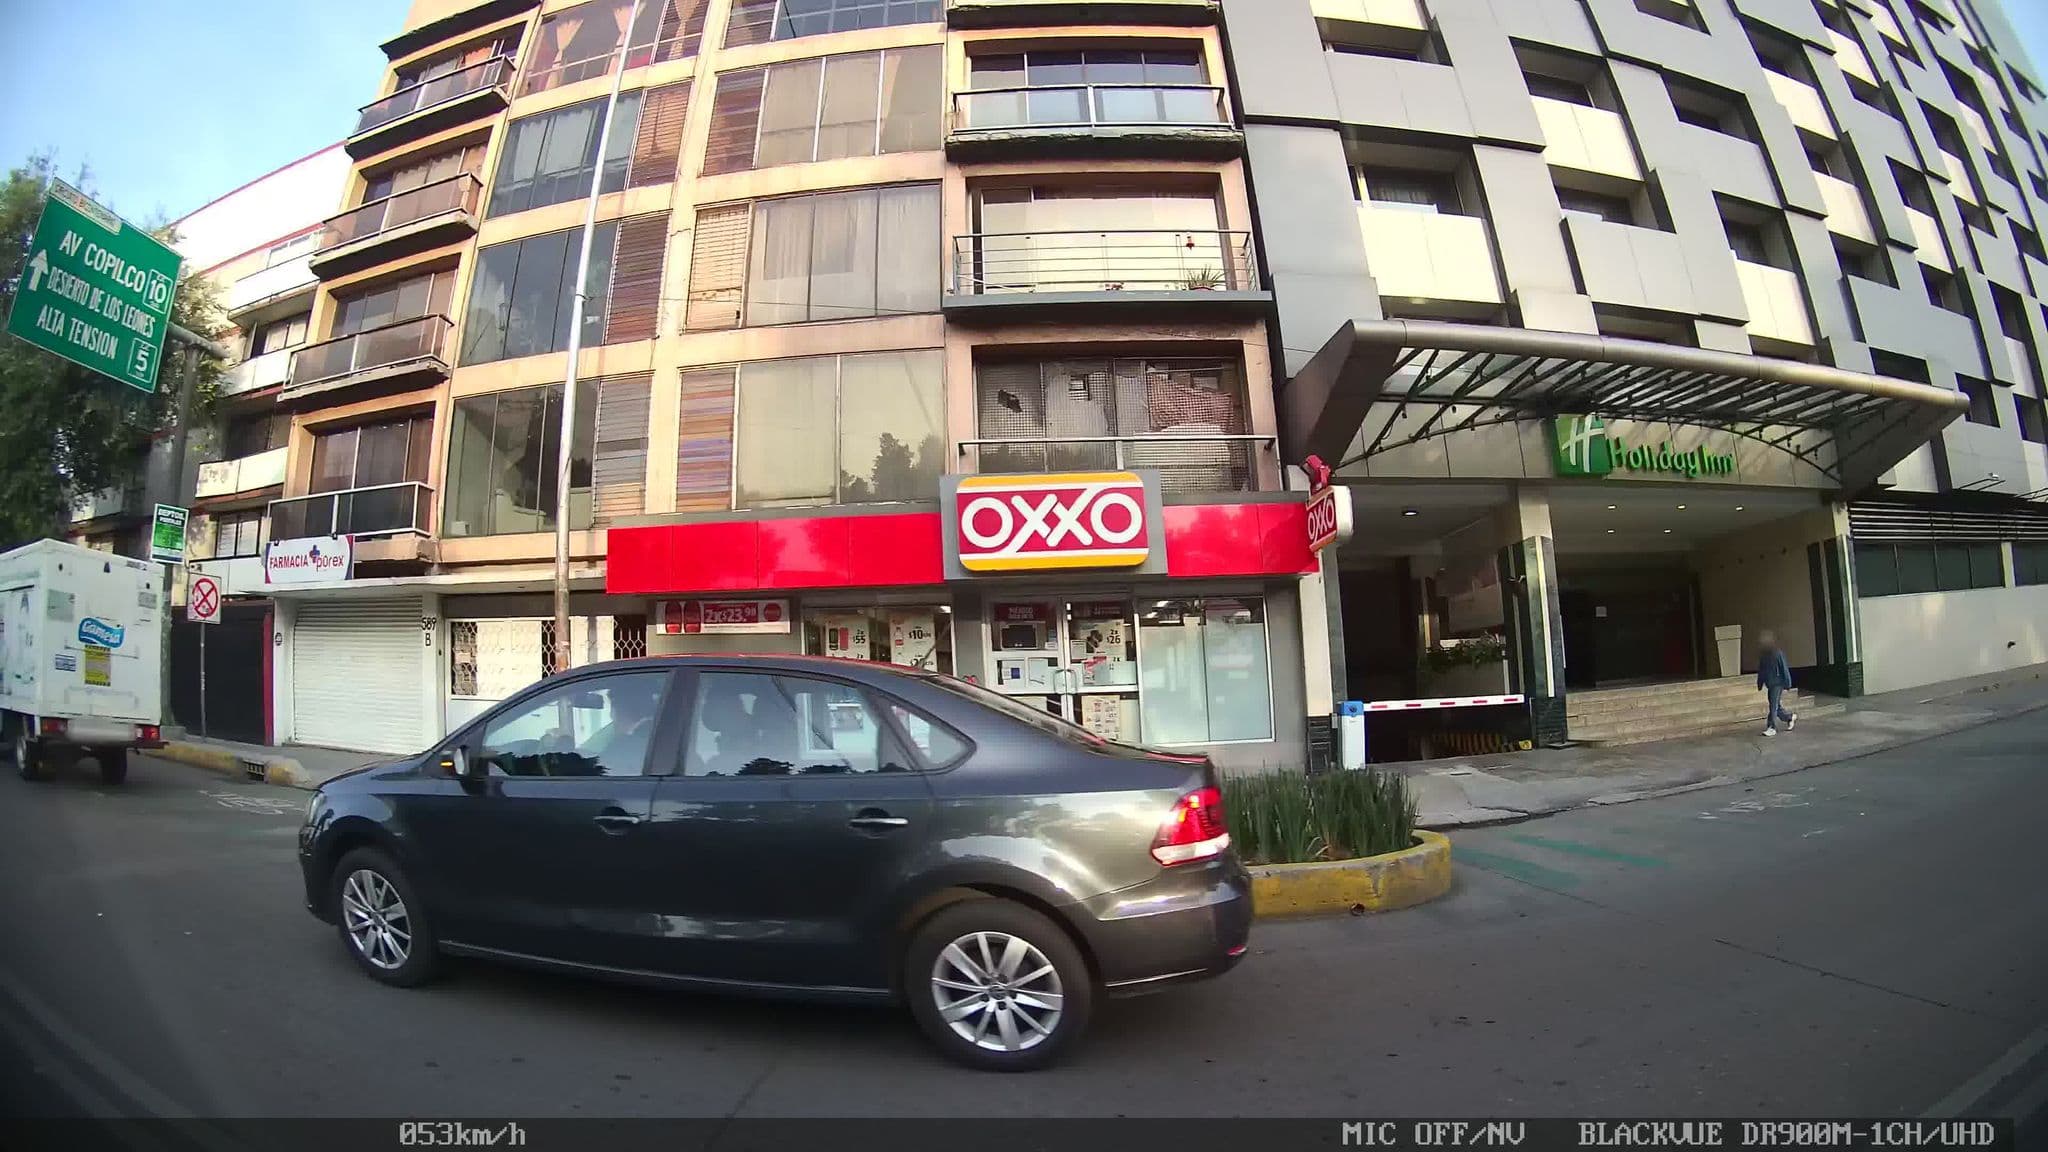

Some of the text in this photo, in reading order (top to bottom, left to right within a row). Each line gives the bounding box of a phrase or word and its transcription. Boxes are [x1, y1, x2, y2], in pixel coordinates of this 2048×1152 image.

[59, 230, 146, 293] AV COPILCO
[47, 266, 156, 338] DESIERTO DE LOS LEONES
[149, 279, 167, 304] 10
[36, 304, 119, 360] ALTA TENSION
[134, 350, 149, 372] 5
[1606, 436, 1733, 478] Holiday Inn
[961, 484, 1143, 552] OXXO
[1307, 496, 1335, 543] OXXO
[269, 555, 309, 569] FARMACIA
[422, 617, 437, 632] 589
[425, 633, 431, 646] B
